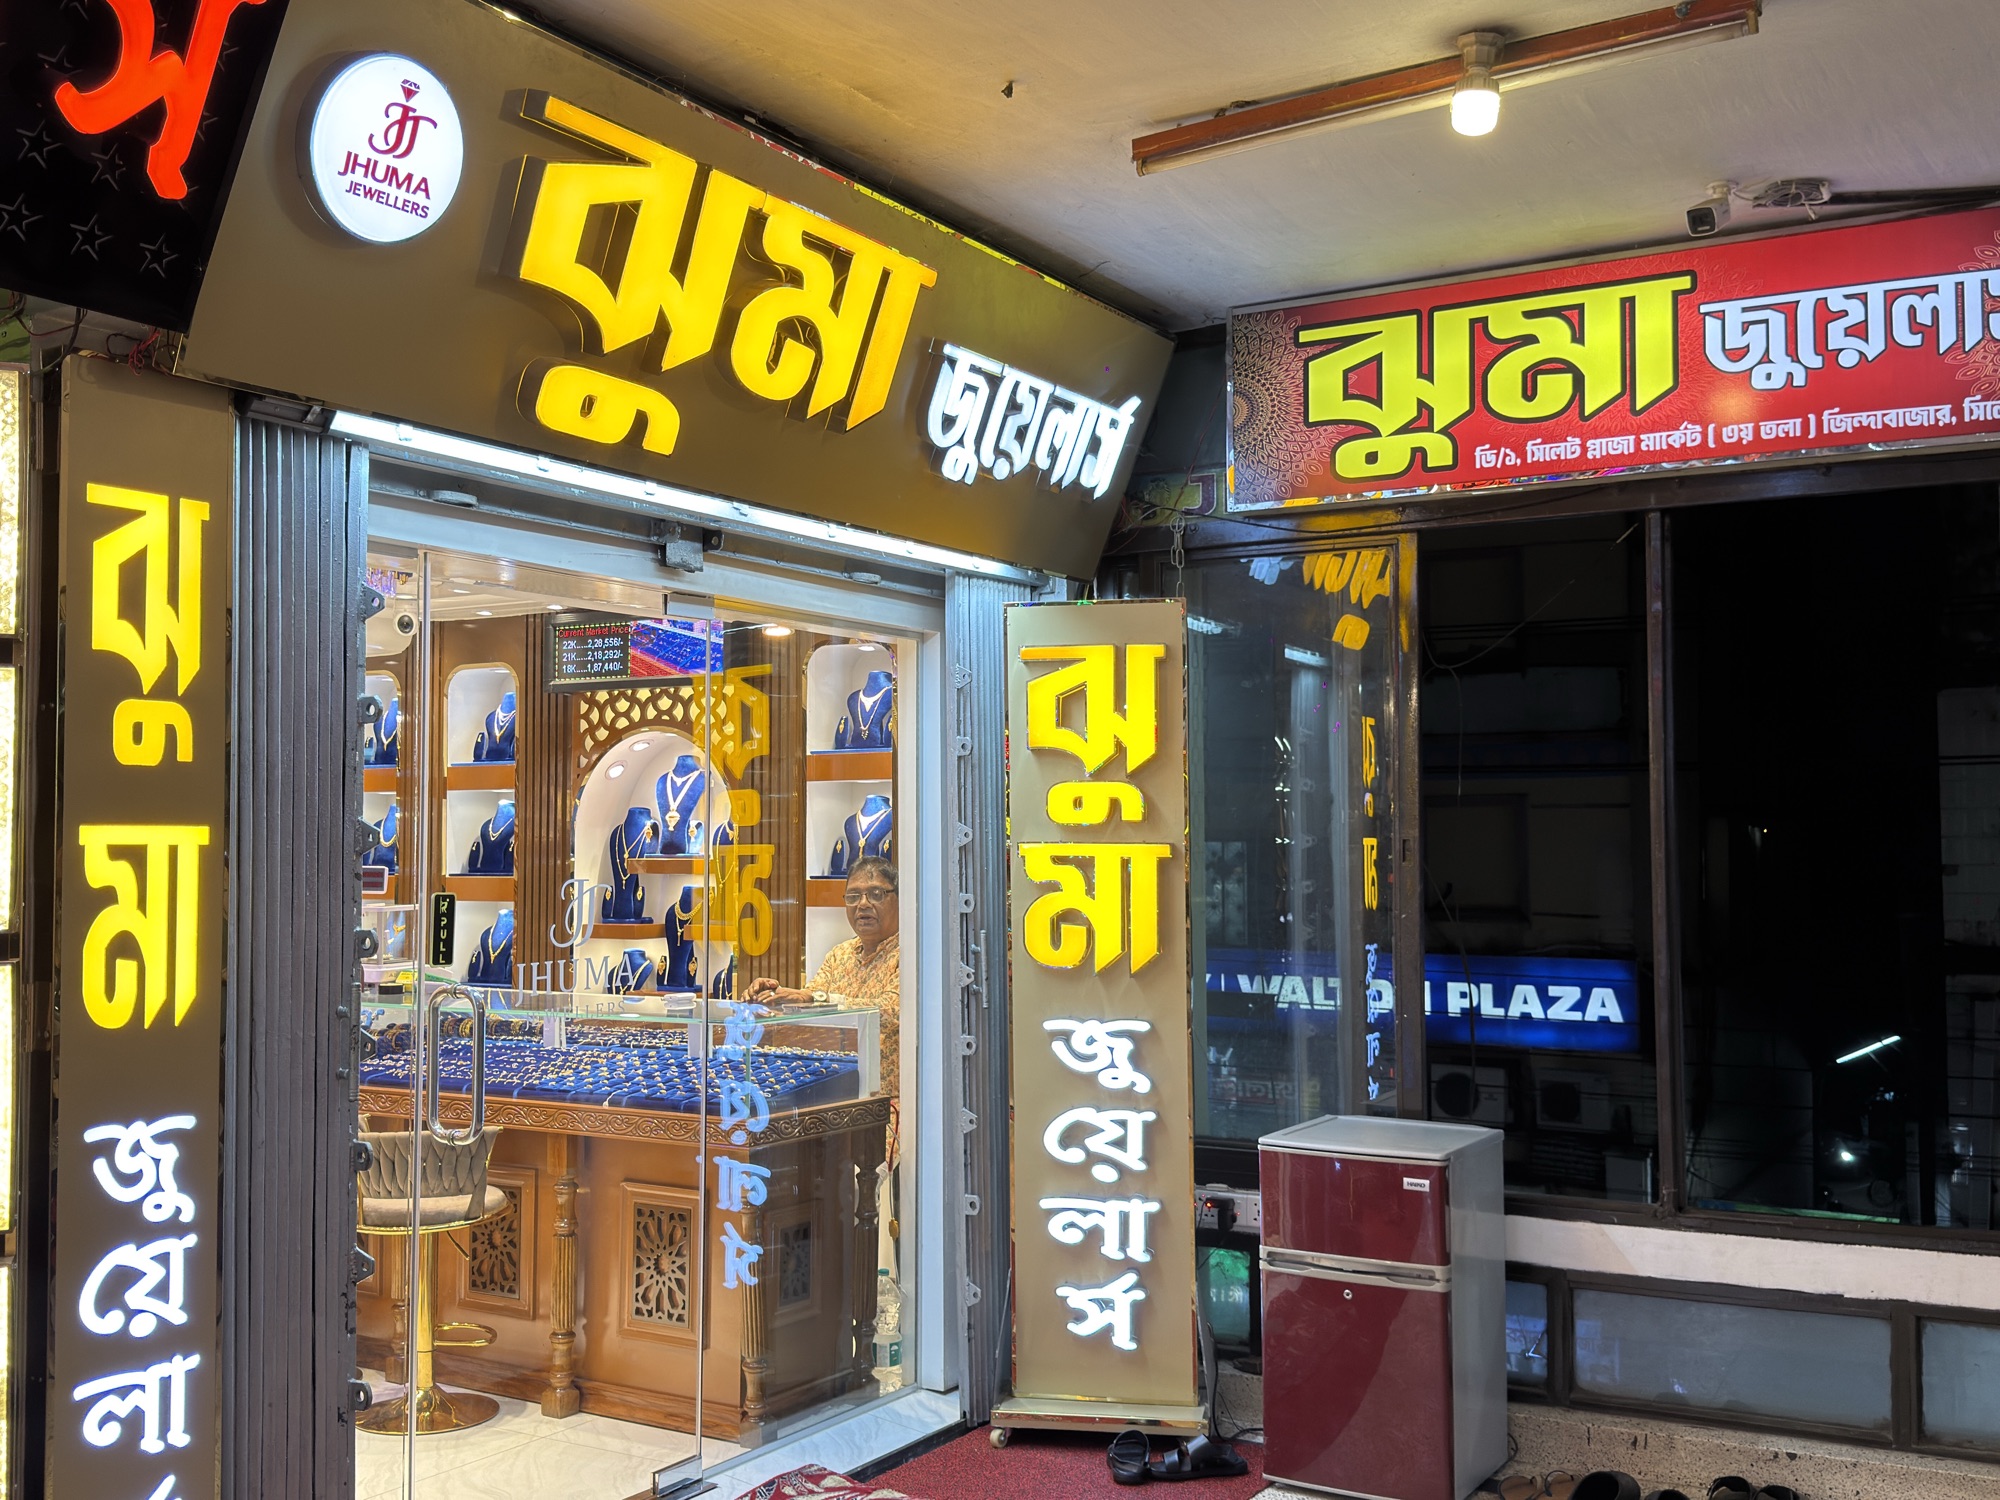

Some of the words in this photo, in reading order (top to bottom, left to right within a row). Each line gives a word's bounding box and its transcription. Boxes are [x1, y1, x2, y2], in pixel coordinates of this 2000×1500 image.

[337, 150, 431, 200] JHUMA
[345, 180, 430, 219] JEWELLERS
[519, 95, 938, 456] ঝুমা
[927, 342, 1142, 499] জুয়েলার্স
[1297, 272, 1696, 481] ঝুমা
[1699, 267, 2000, 390] জুয়েলা
[1525, 437, 1582, 464] সিলেট
[1586, 435, 1636, 460] প্লাজা
[1640, 421, 1702, 452] মার্কেট
[1758, 418, 1803, 440] তলা
[558, 628, 584, 638] Current
[586, 627, 609, 636] Market
[611, 626, 629, 634] Price
[78, 482, 211, 1031] ঝুমা
[1017, 644, 1171, 975] ঝুমা
[439, 916, 448, 964] PULL
[515, 953, 634, 1007] JHUMA
[1447, 981, 1626, 1024] PLAZA
[1039, 1017, 1160, 1351] জুয়েলার্স
